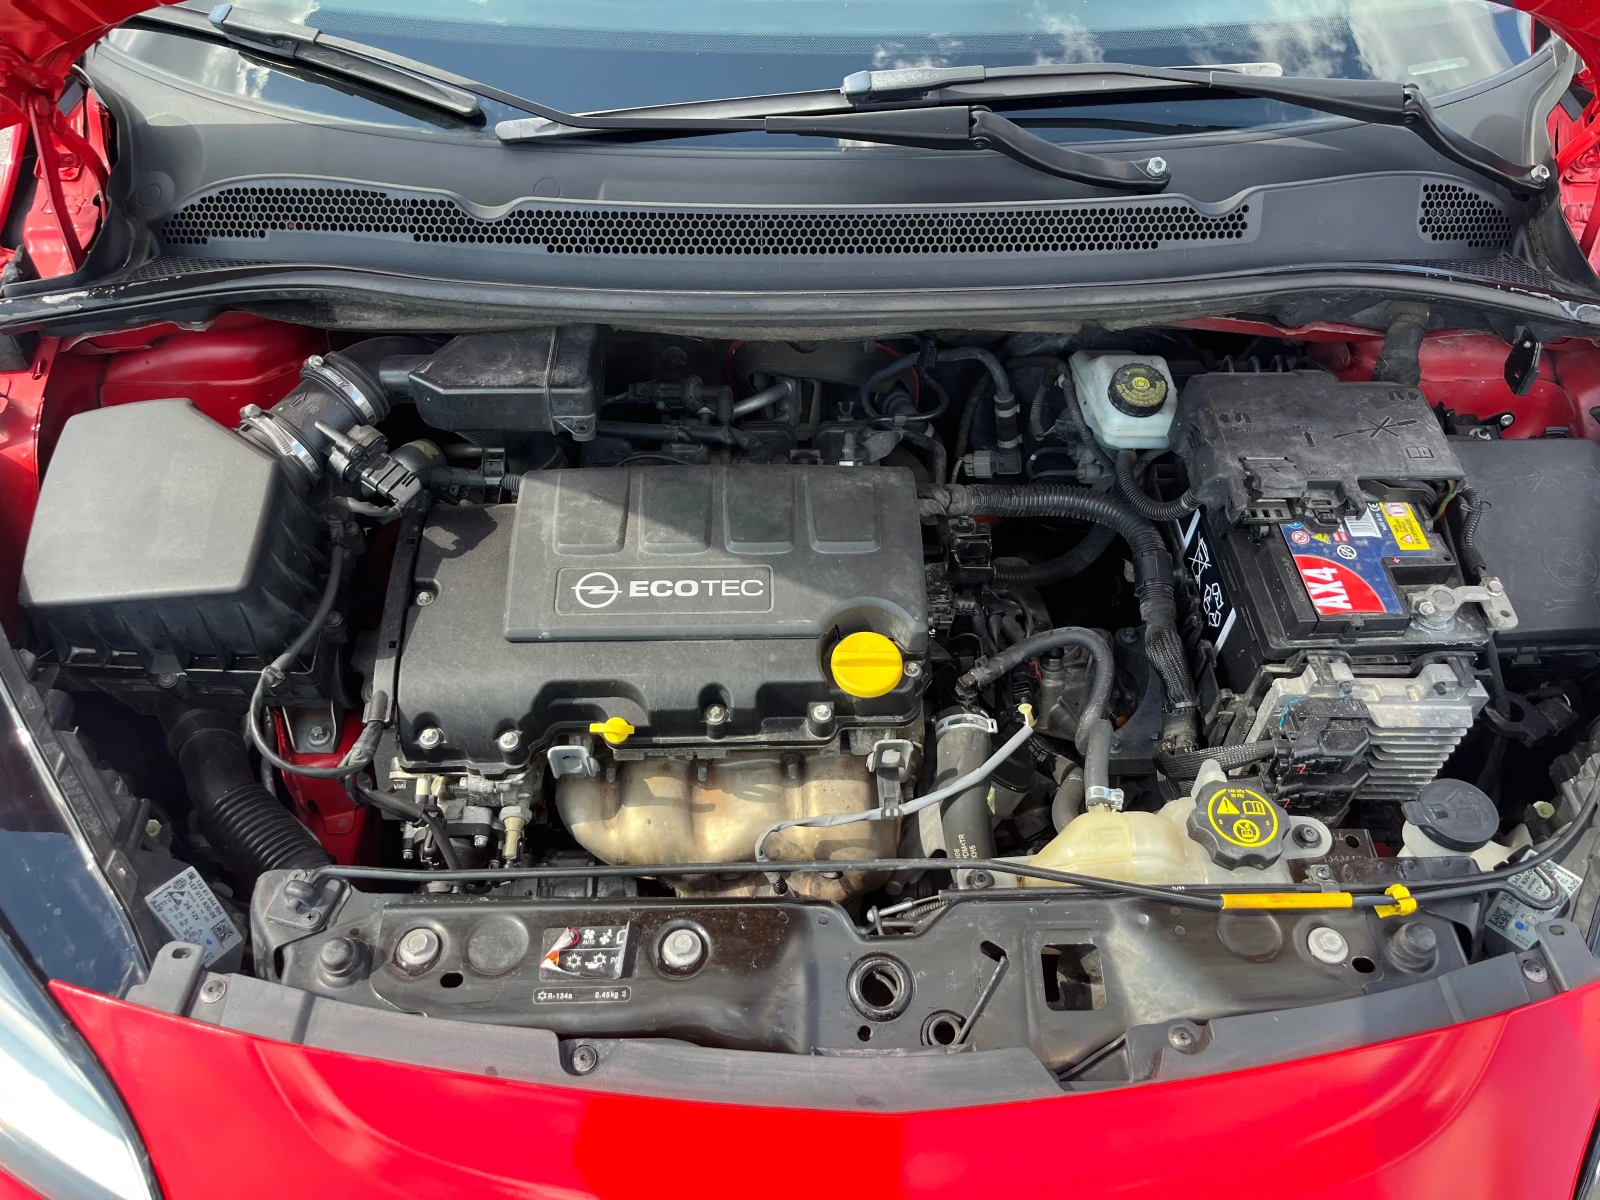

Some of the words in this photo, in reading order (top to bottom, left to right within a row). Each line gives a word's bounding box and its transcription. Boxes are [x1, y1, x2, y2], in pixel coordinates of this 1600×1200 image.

[629, 579, 764, 598] ECOTEC
[1302, 566, 1353, 610] AX4
[1533, 884, 1543, 895] 12V
[1567, 878, 1579, 891] A29
[150, 898, 163, 912] A29
[190, 910, 200, 921] 12V
